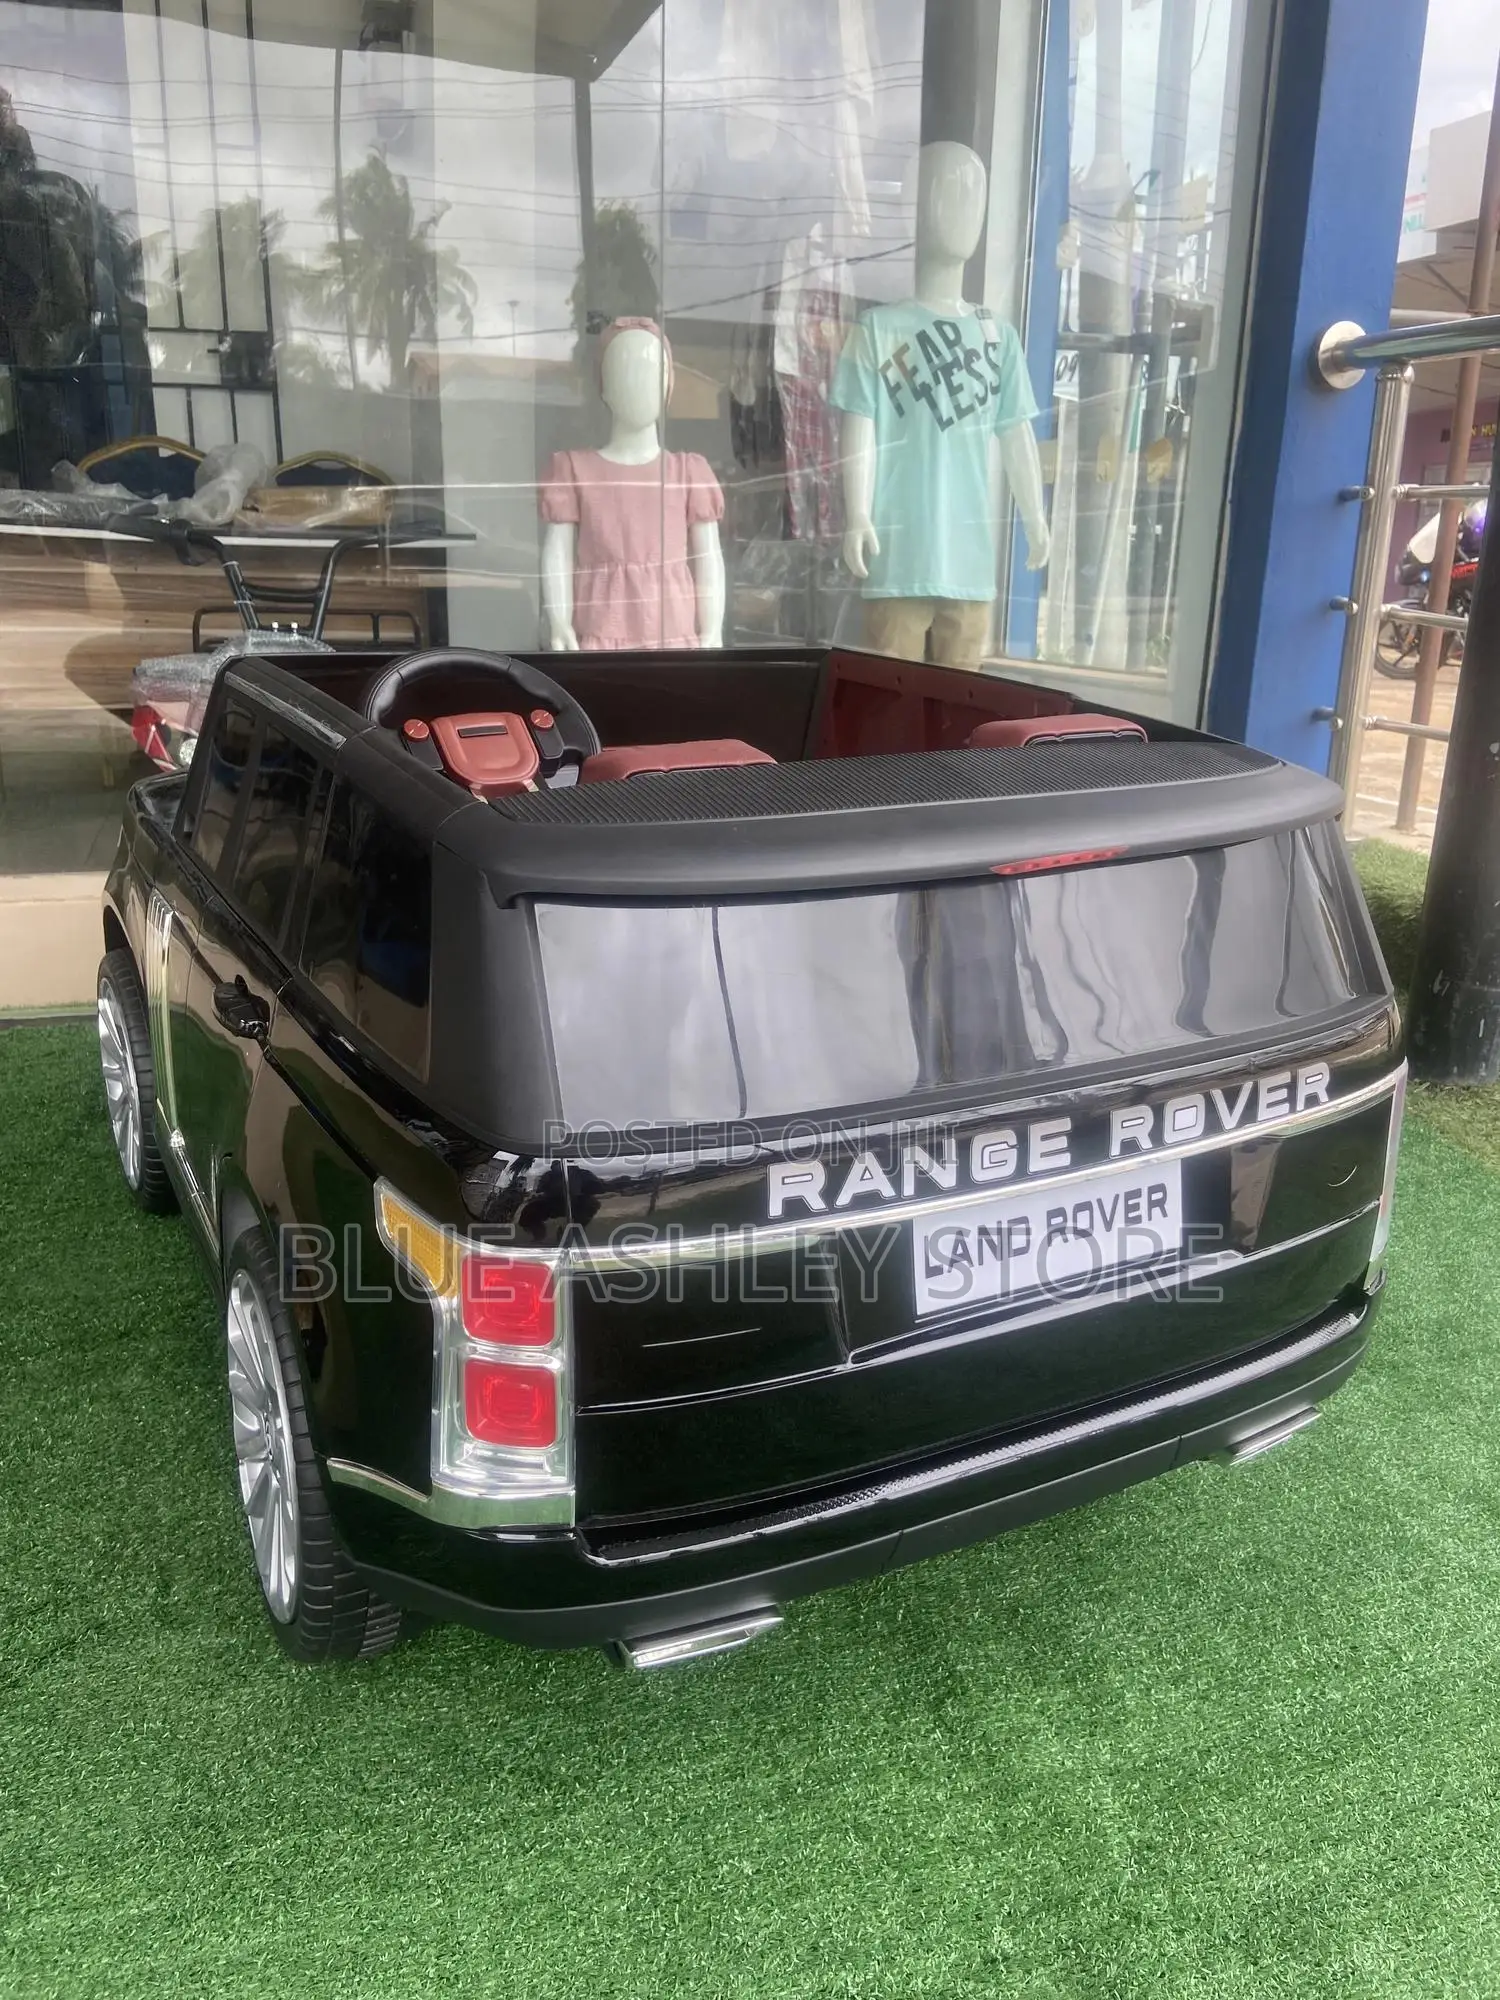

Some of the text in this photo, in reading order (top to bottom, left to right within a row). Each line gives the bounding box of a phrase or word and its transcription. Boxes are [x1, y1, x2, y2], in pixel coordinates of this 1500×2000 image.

[918, 340, 1000, 432] LESS
[768, 1062, 1331, 1218] RANGE ROVER
[924, 1182, 1169, 1279] LAND ROVER
